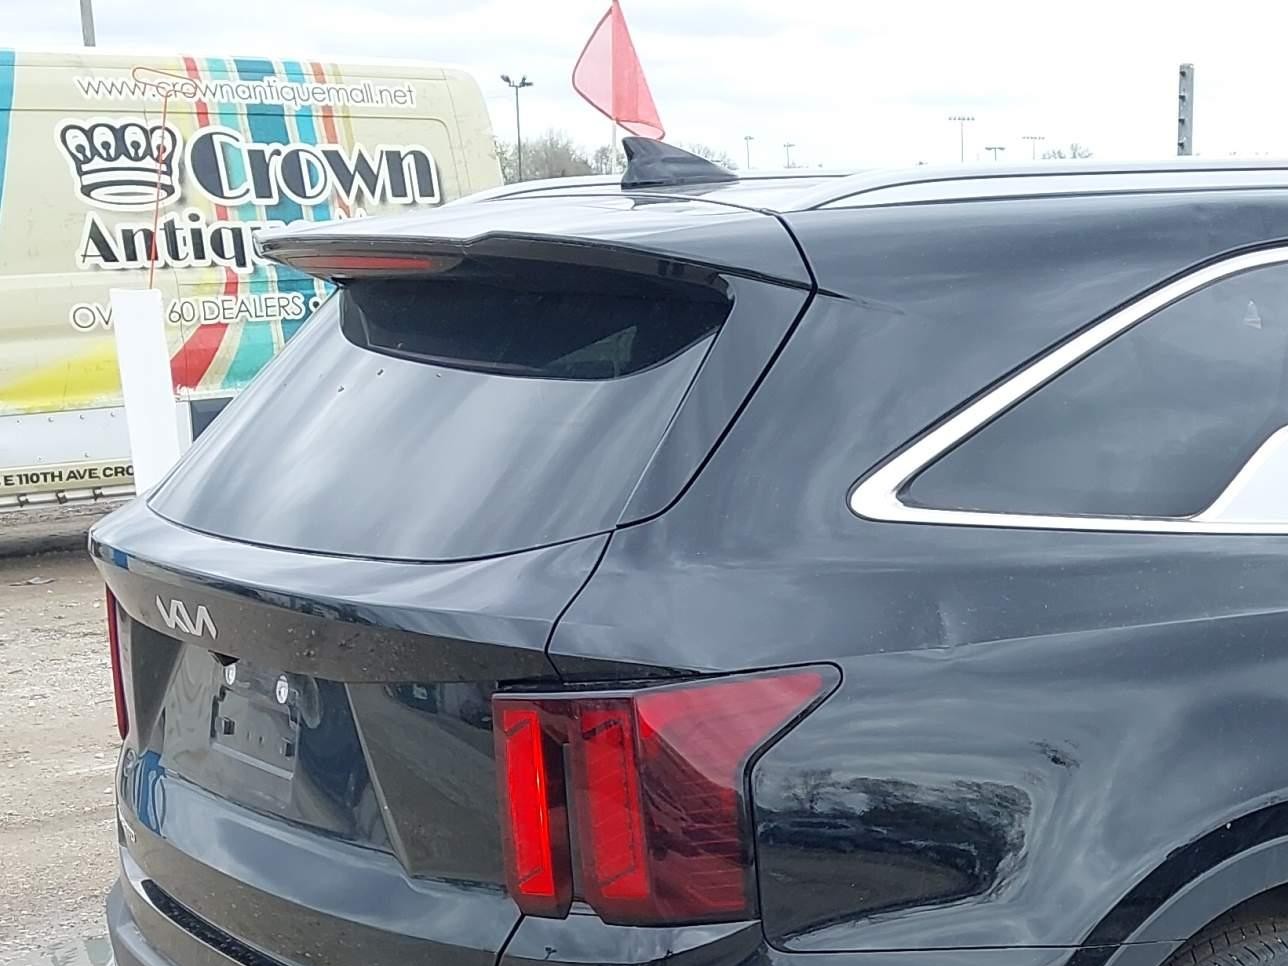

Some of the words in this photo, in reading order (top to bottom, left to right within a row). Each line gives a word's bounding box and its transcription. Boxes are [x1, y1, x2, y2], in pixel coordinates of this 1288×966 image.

[77, 78, 416, 111] www.crownantiquemall.net
[189, 130, 438, 200] Crown
[81, 212, 281, 268] Antiq
[72, 304, 113, 328] OV
[168, 302, 196, 323] 60
[202, 295, 303, 321] DEALERS
[16, 470, 63, 486] 110TH
[66, 468, 99, 482] AVE
[102, 465, 134, 478] CRO
